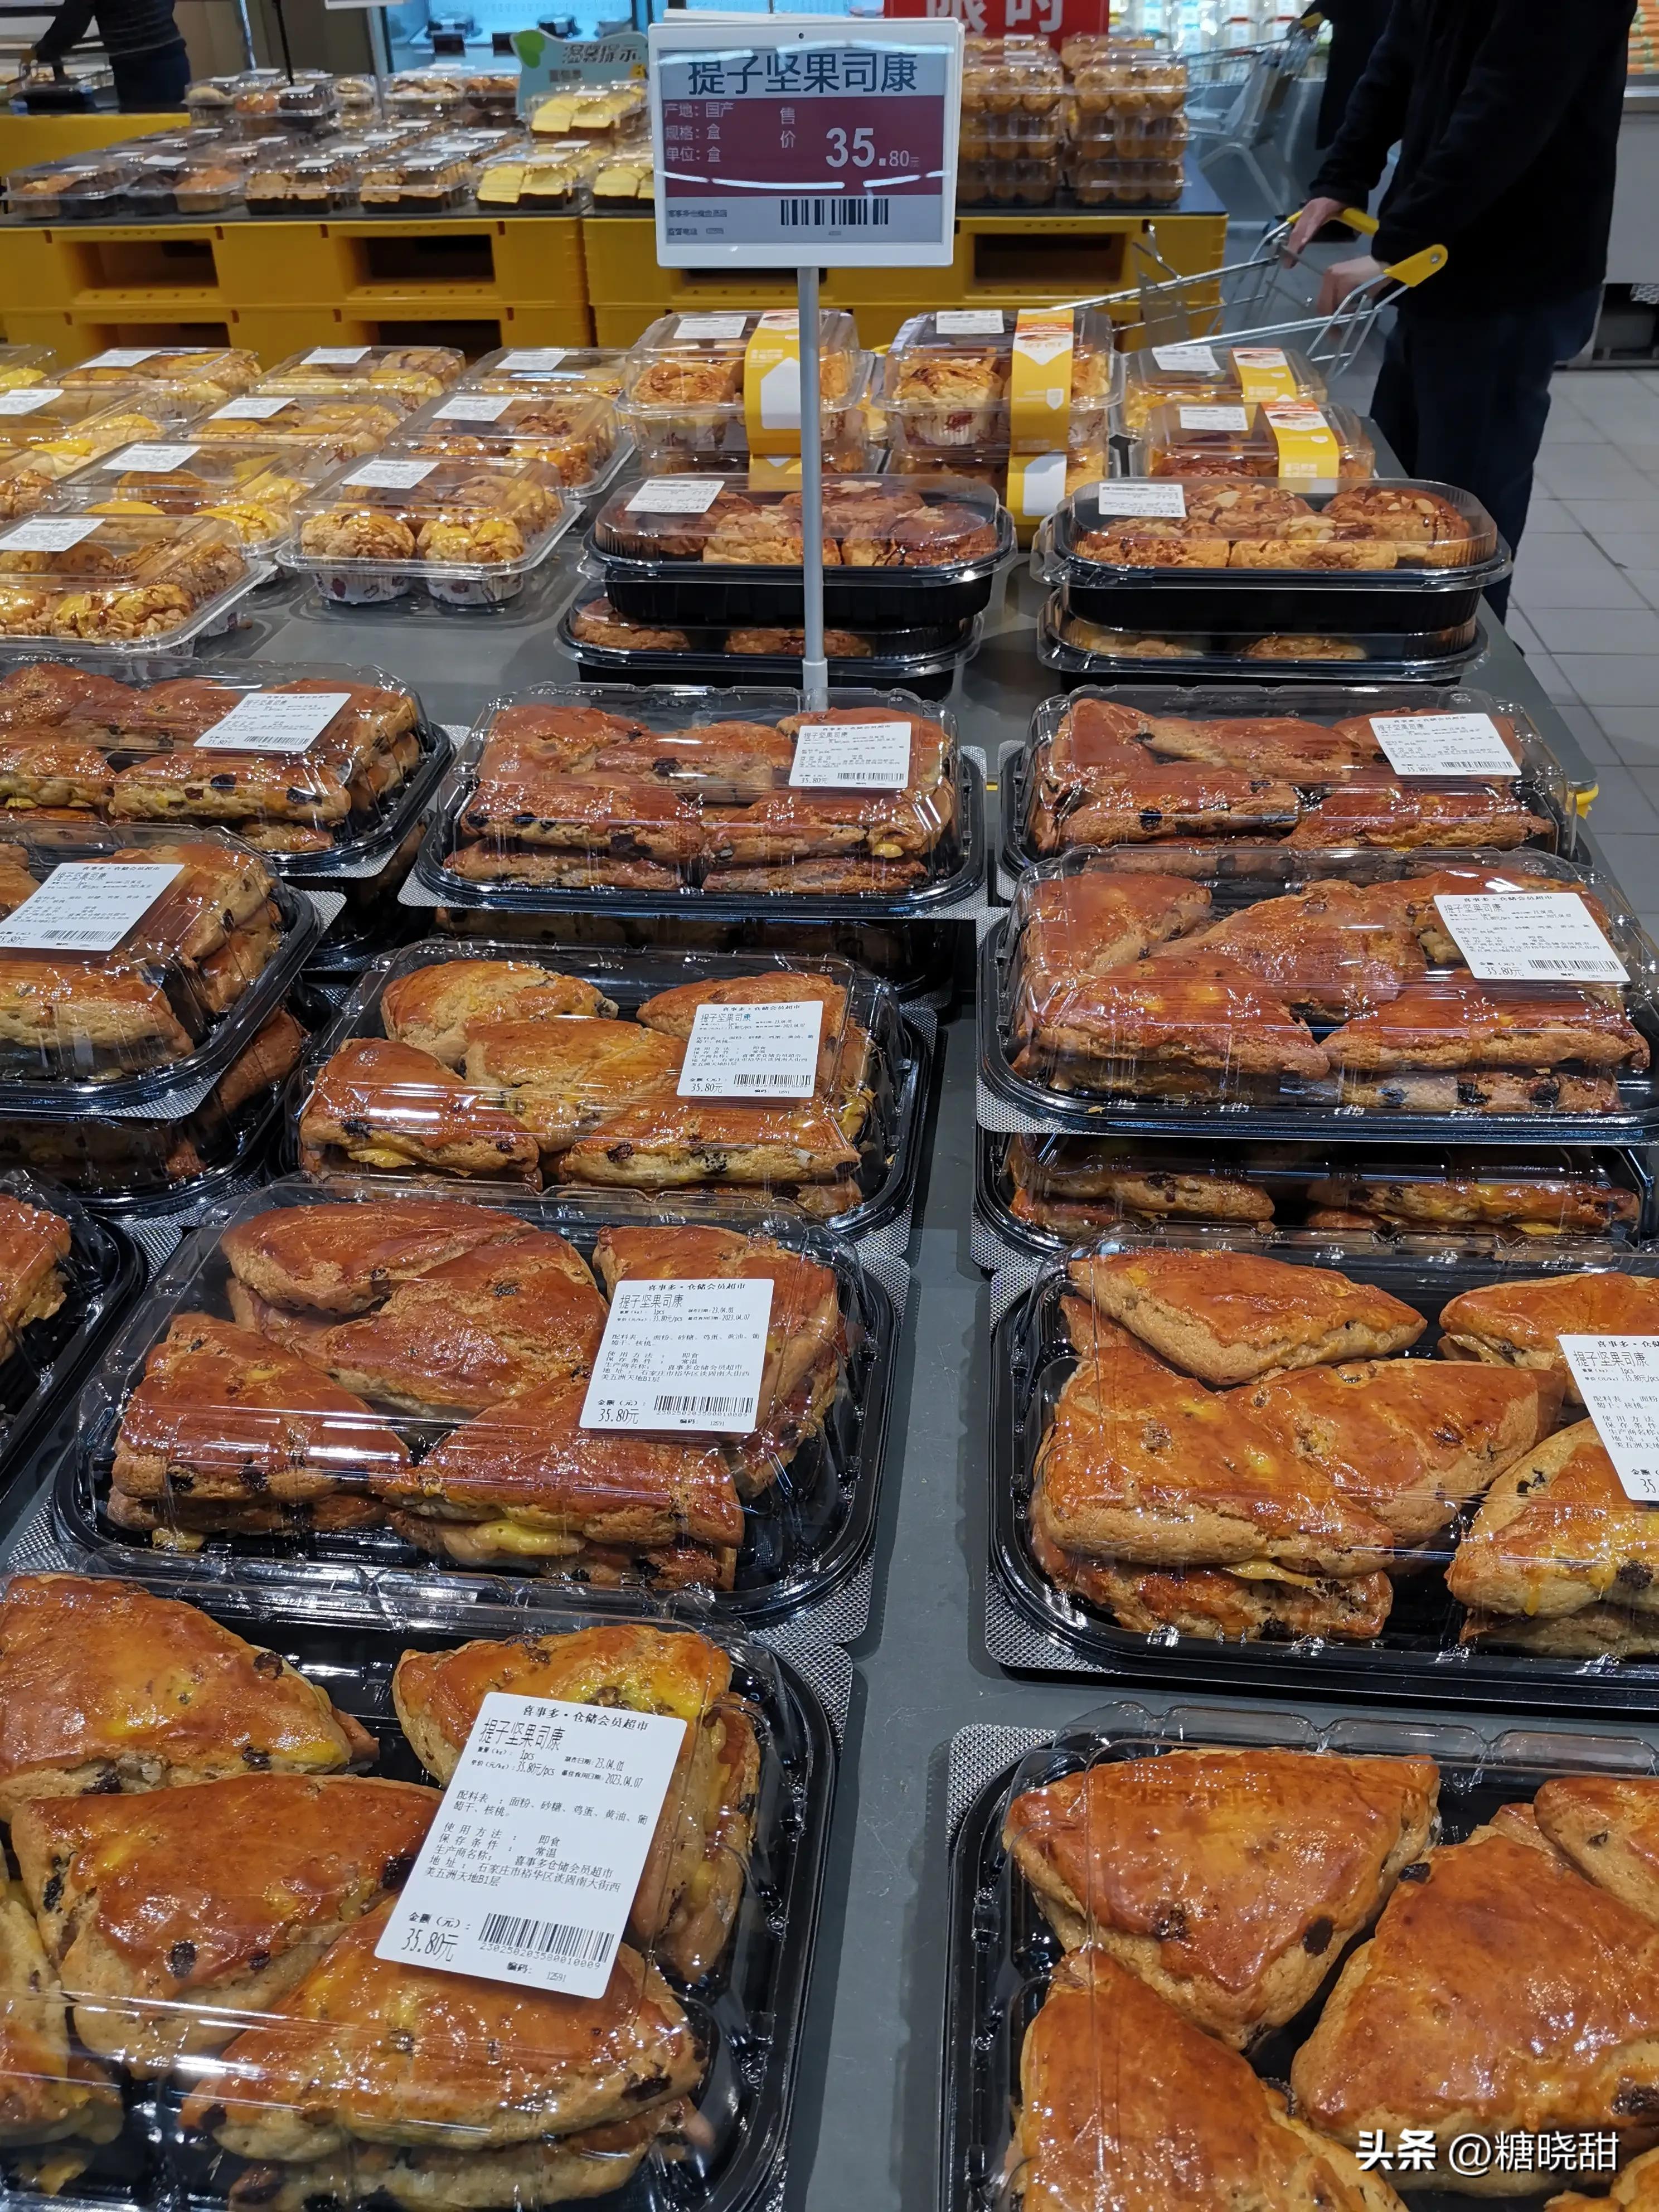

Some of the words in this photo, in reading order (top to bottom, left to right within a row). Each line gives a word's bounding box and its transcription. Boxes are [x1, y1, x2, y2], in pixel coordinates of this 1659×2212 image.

[688, 52, 918, 95] 提子坚果司康
[1486, 966, 1525, 977] 35.80元
[691, 1082, 723, 1093] 35.80元
[619, 1293, 685, 1309] 提子坚果司康
[1573, 1350, 1650, 1367] 提子坚果司康
[598, 1408, 639, 1425] 35.80元
[522, 1705, 649, 1731] 喜事多·仓储会员超市
[479, 1717, 565, 1751] 提子坚果司康
[538, 1835, 562, 1847] 即食
[535, 1846, 557, 1858] 常温
[401, 1927, 460, 1963] 35.80元
[545, 1970, 567, 1983] 12591
